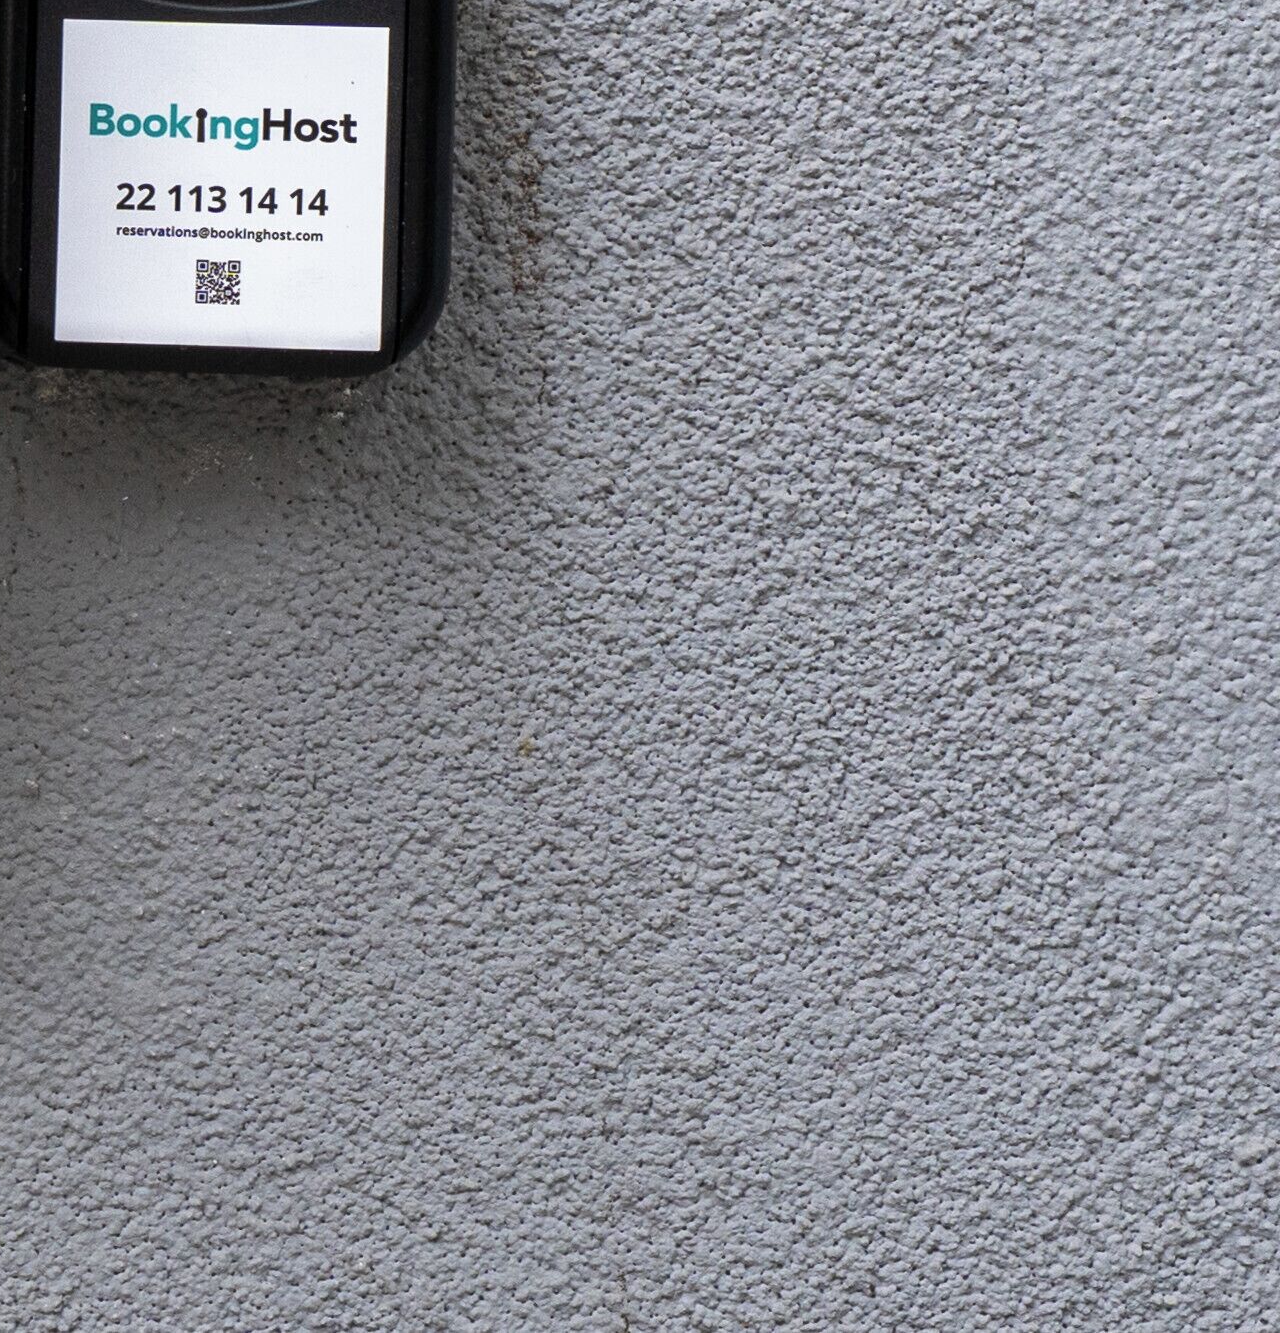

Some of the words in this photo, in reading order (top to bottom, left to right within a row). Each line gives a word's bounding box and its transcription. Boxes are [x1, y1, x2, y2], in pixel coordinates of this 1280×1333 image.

[89, 103, 358, 151] BookingHost
[115, 182, 157, 212] 22
[167, 184, 228, 214] 113
[239, 186, 278, 215] 14
[289, 188, 329, 217] 14
[116, 224, 324, 243] reservations@bookinghost.com
